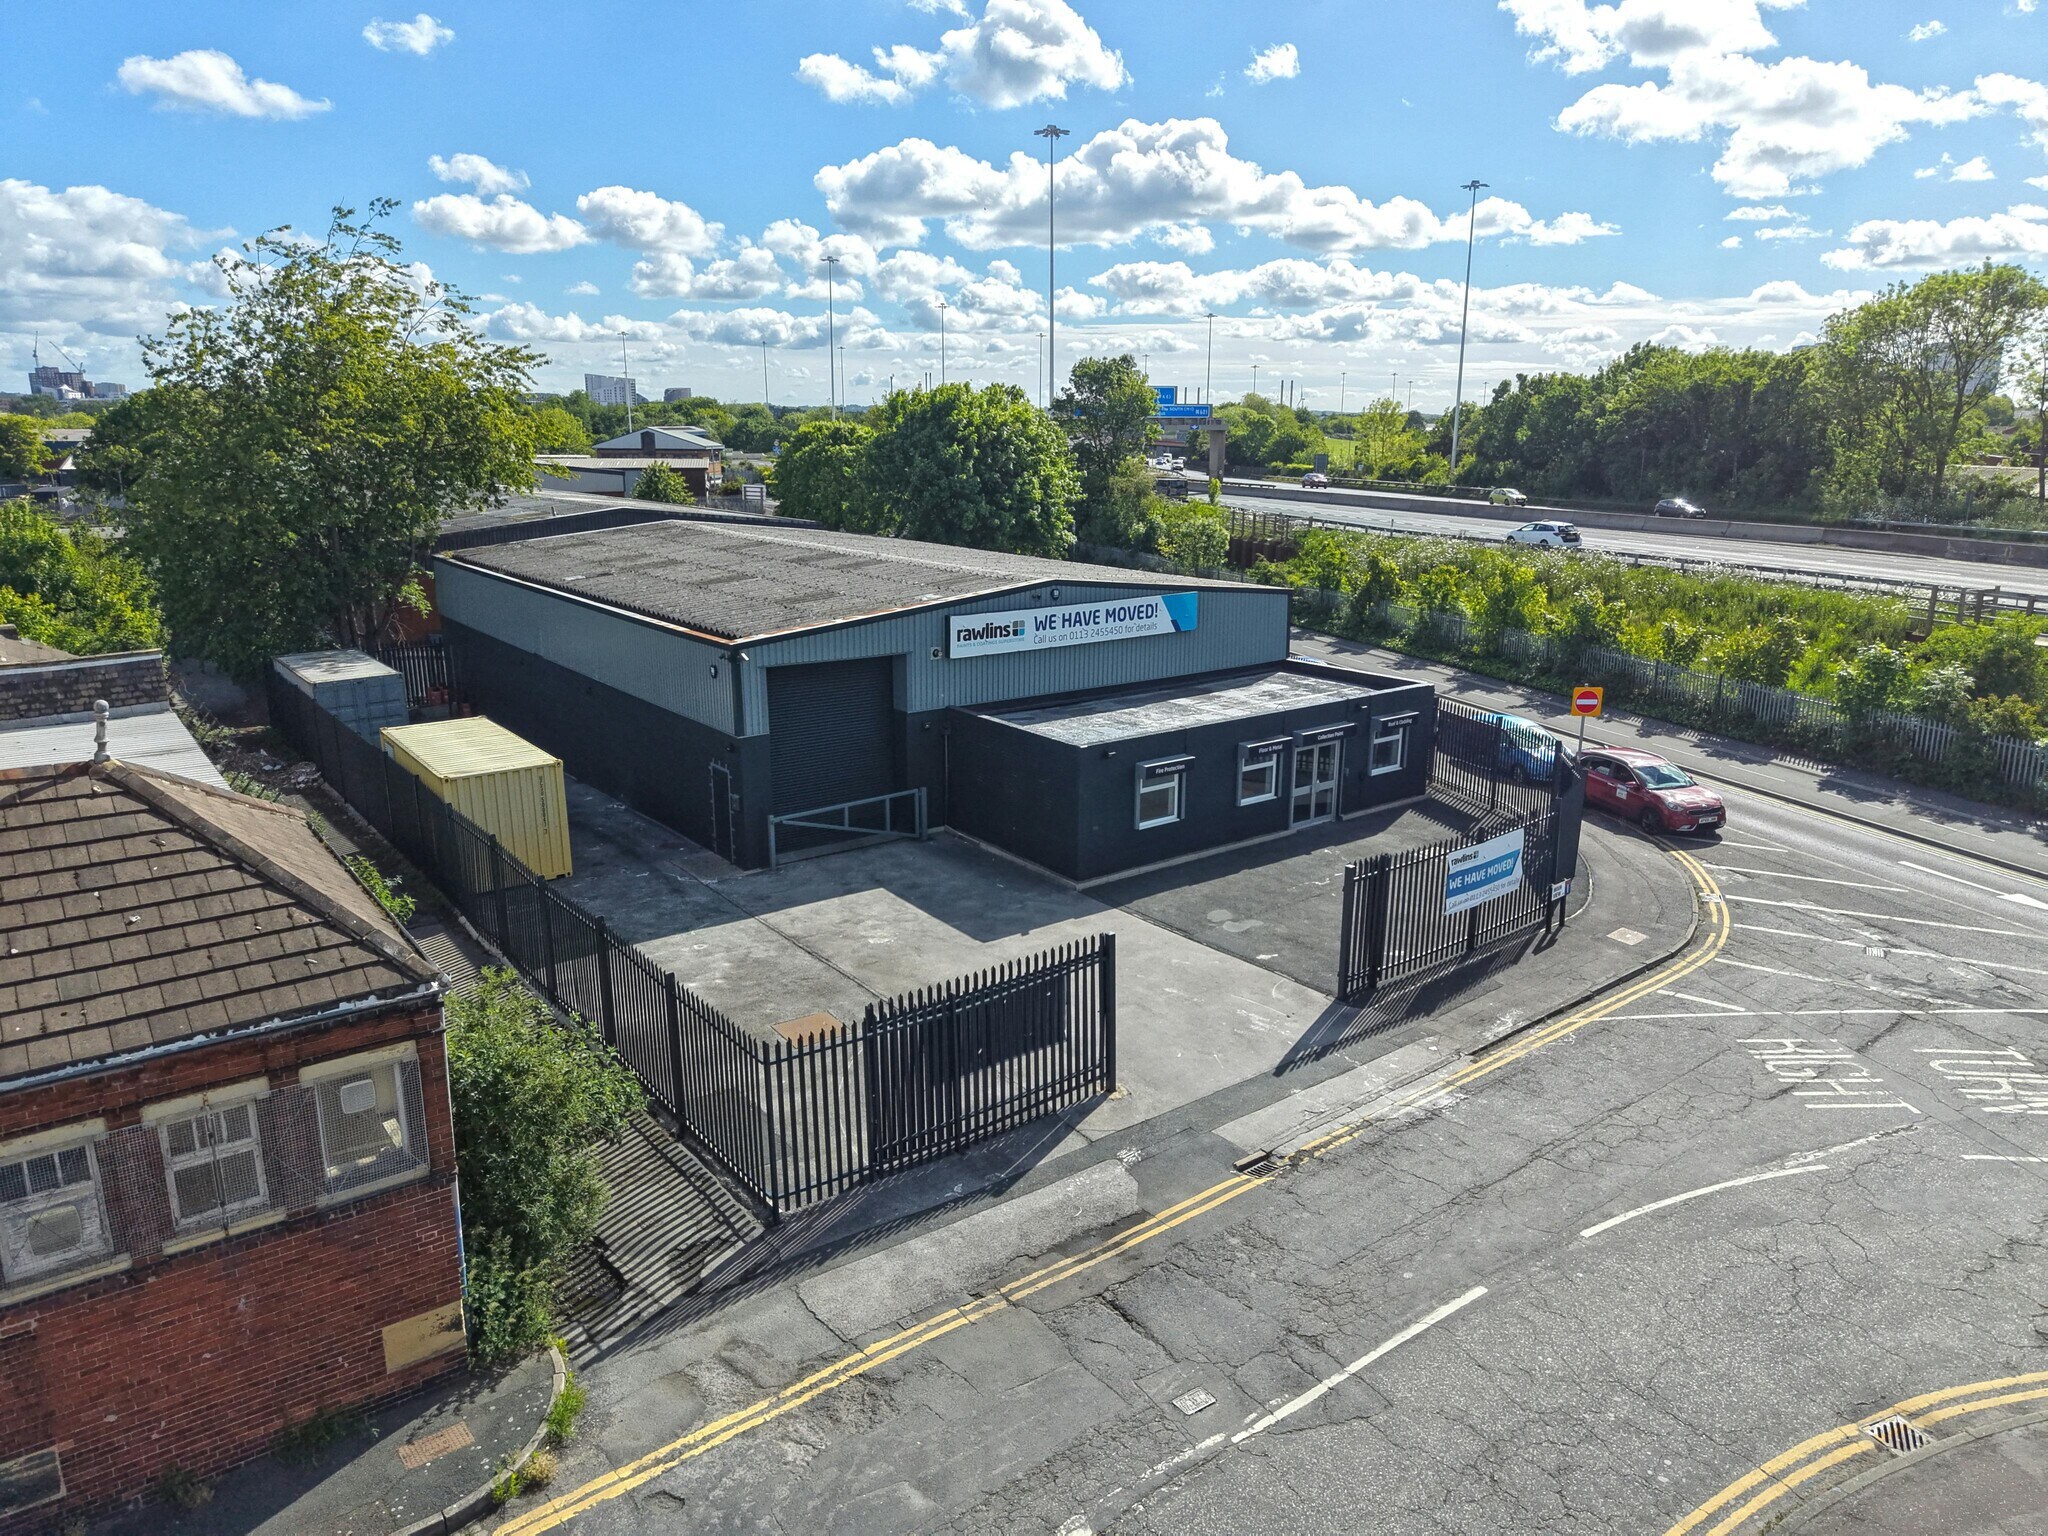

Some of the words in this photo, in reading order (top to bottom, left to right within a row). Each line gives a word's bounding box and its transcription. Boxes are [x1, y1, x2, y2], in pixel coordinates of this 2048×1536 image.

[1033, 613, 1057, 632] WE
[1061, 609, 1101, 629] HAVE
[1105, 602, 1158, 624] MOVED!
[956, 622, 1011, 642] rawlins
[1033, 634, 1047, 645] Call
[1048, 635, 1057, 643] us
[1058, 633, 1068, 641] on
[1069, 630, 1088, 641] 0113
[1090, 625, 1124, 638] 2455450
[1125, 624, 1134, 633] for
[1135, 621, 1158, 632] details
[1164, 764, 1185, 772] Protection
[1450, 852, 1473, 867] rawlins
[1449, 875, 1462, 890] WE
[1464, 868, 1487, 886] HAVE
[1487, 857, 1515, 877] MOVED!
[1736, 1038, 1922, 1114] RIGHT
